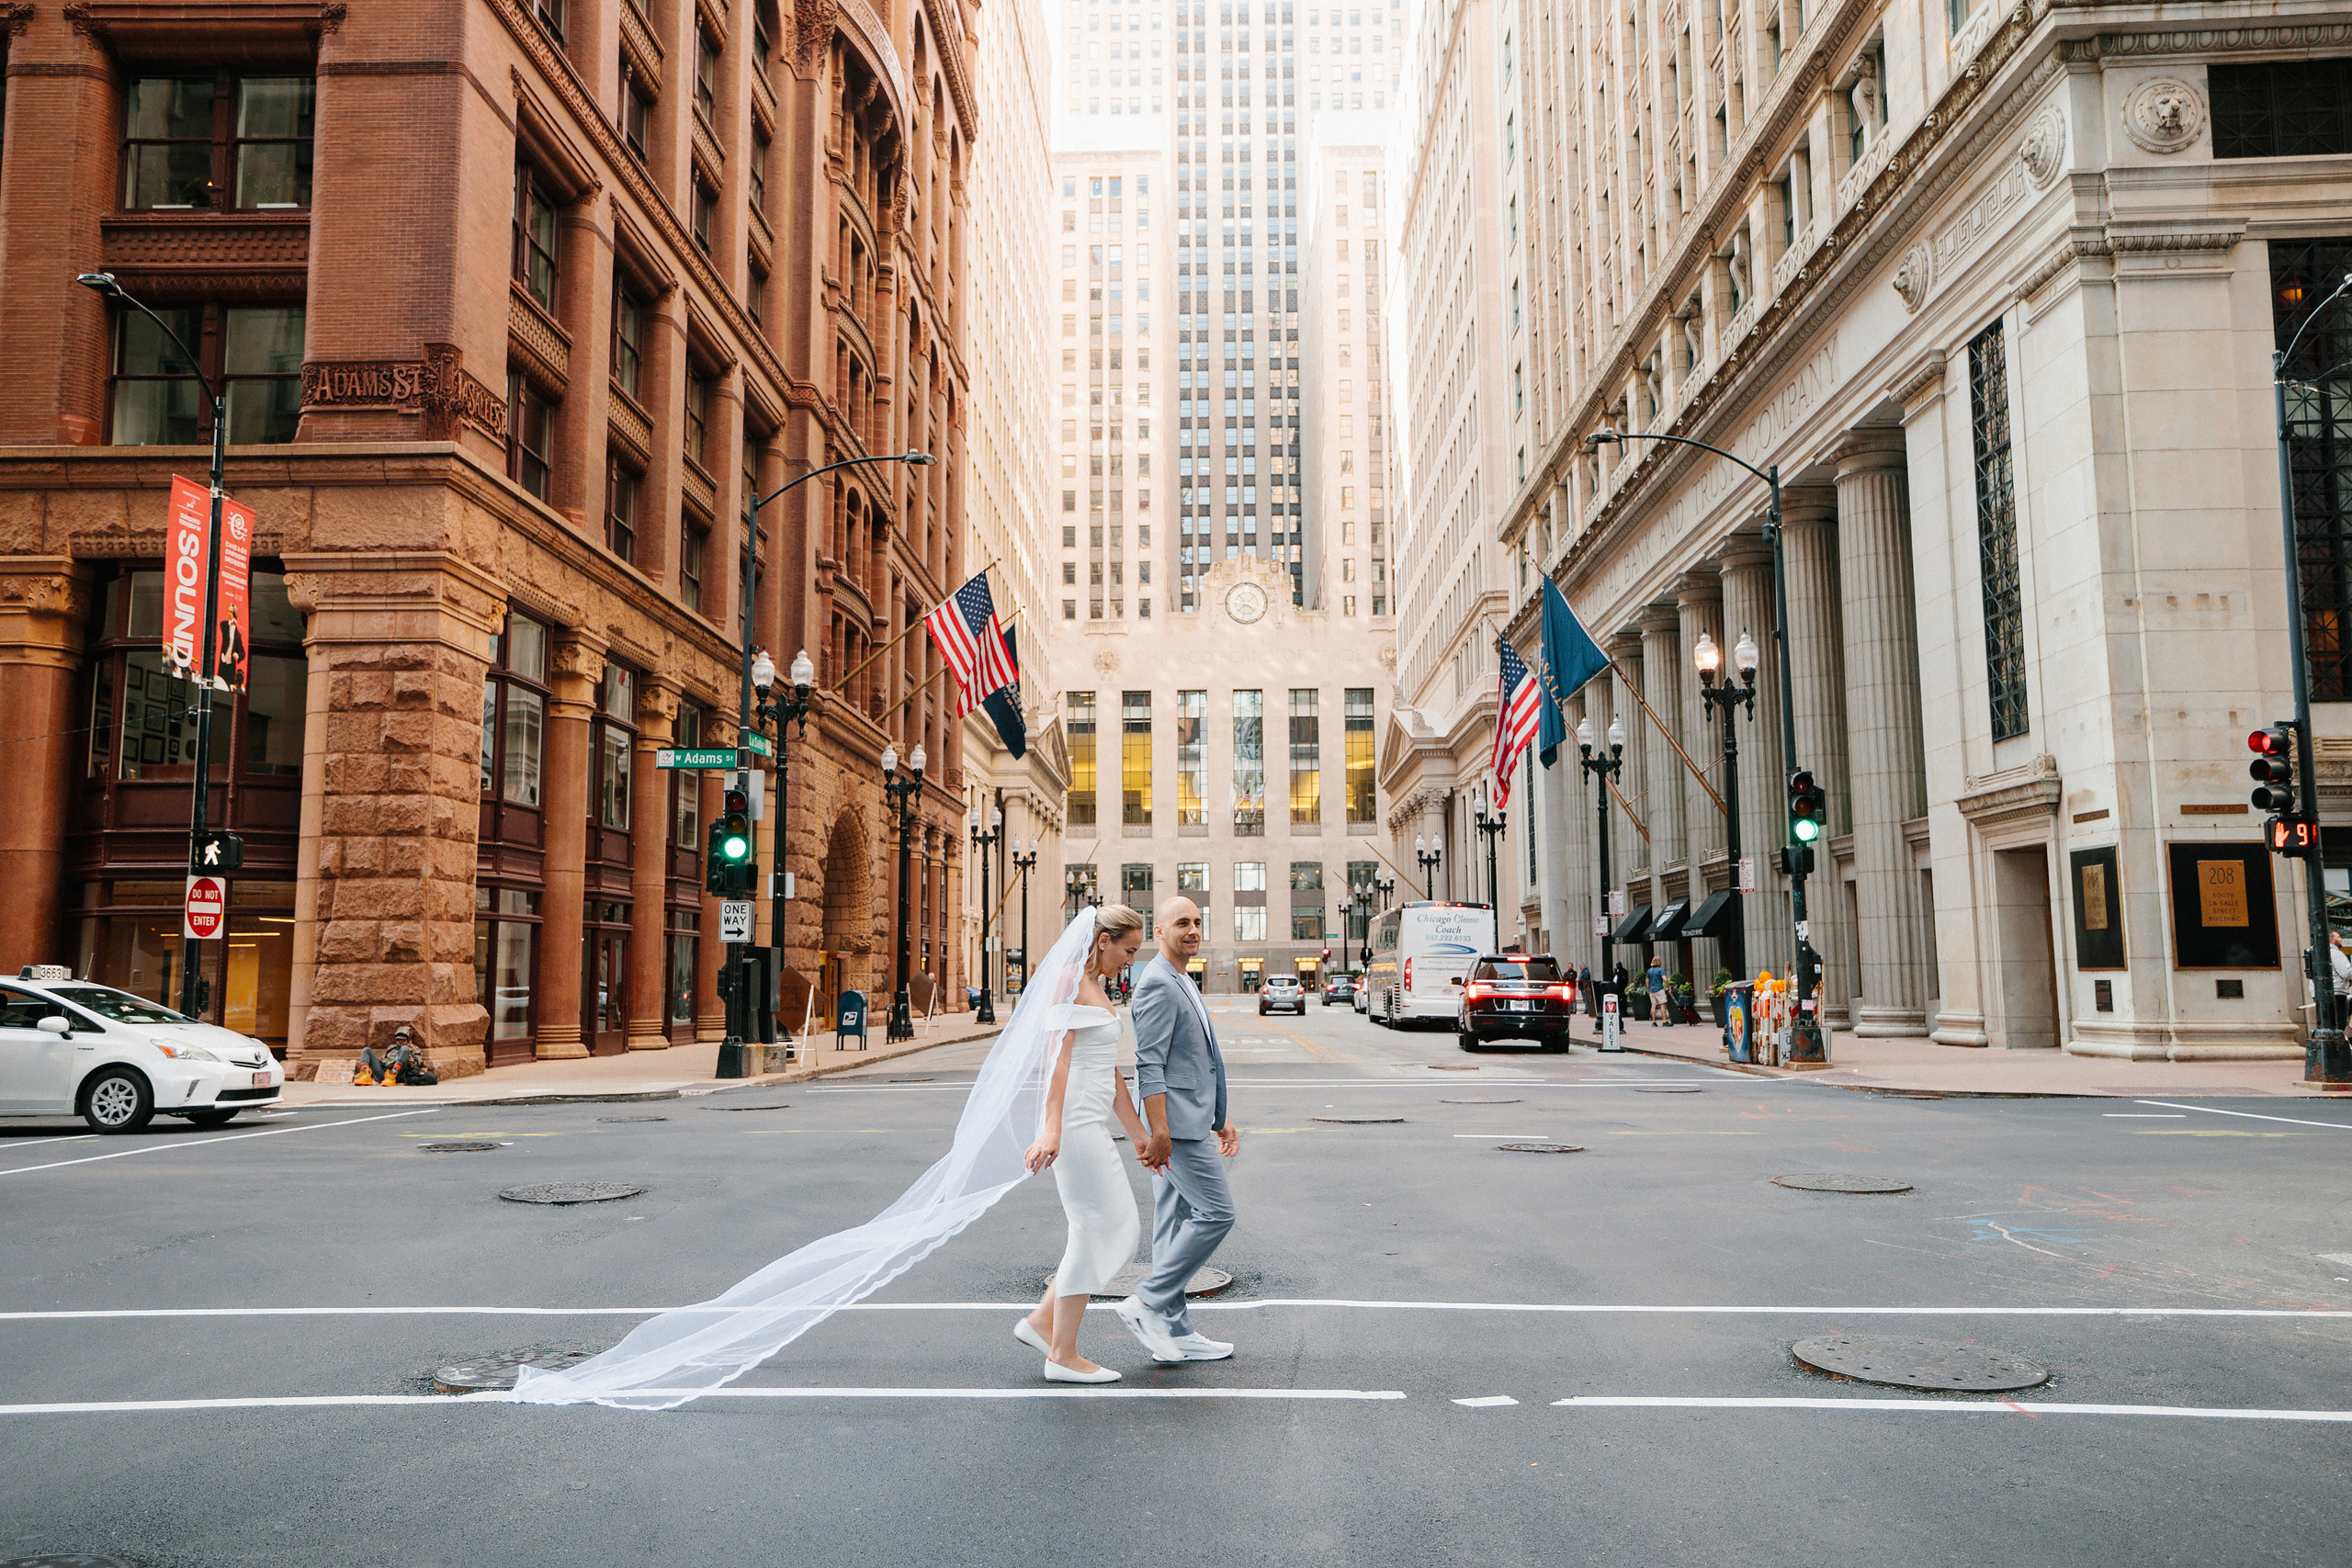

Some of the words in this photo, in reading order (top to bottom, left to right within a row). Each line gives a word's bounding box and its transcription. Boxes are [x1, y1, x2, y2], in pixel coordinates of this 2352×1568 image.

[314, 368, 392, 402] ADAMS
[1623, 527, 1656, 582] BANK
[1659, 500, 1684, 547] AND
[1692, 443, 1739, 515] TRUST
[1745, 336, 1838, 463] COMPANY
[173, 529, 200, 668] SOUND
[684, 752, 723, 764] Adams
[2209, 867, 2234, 885] 208
[192, 888, 202, 899] DO
[205, 889, 220, 900] NOT
[724, 904, 747, 914] ONE
[193, 915, 215, 927] ENTER
[723, 916, 747, 925] WAY
[1417, 913, 1452, 925] Chicago
[1435, 924, 1462, 934] Coach
[40, 967, 62, 979] 3663
